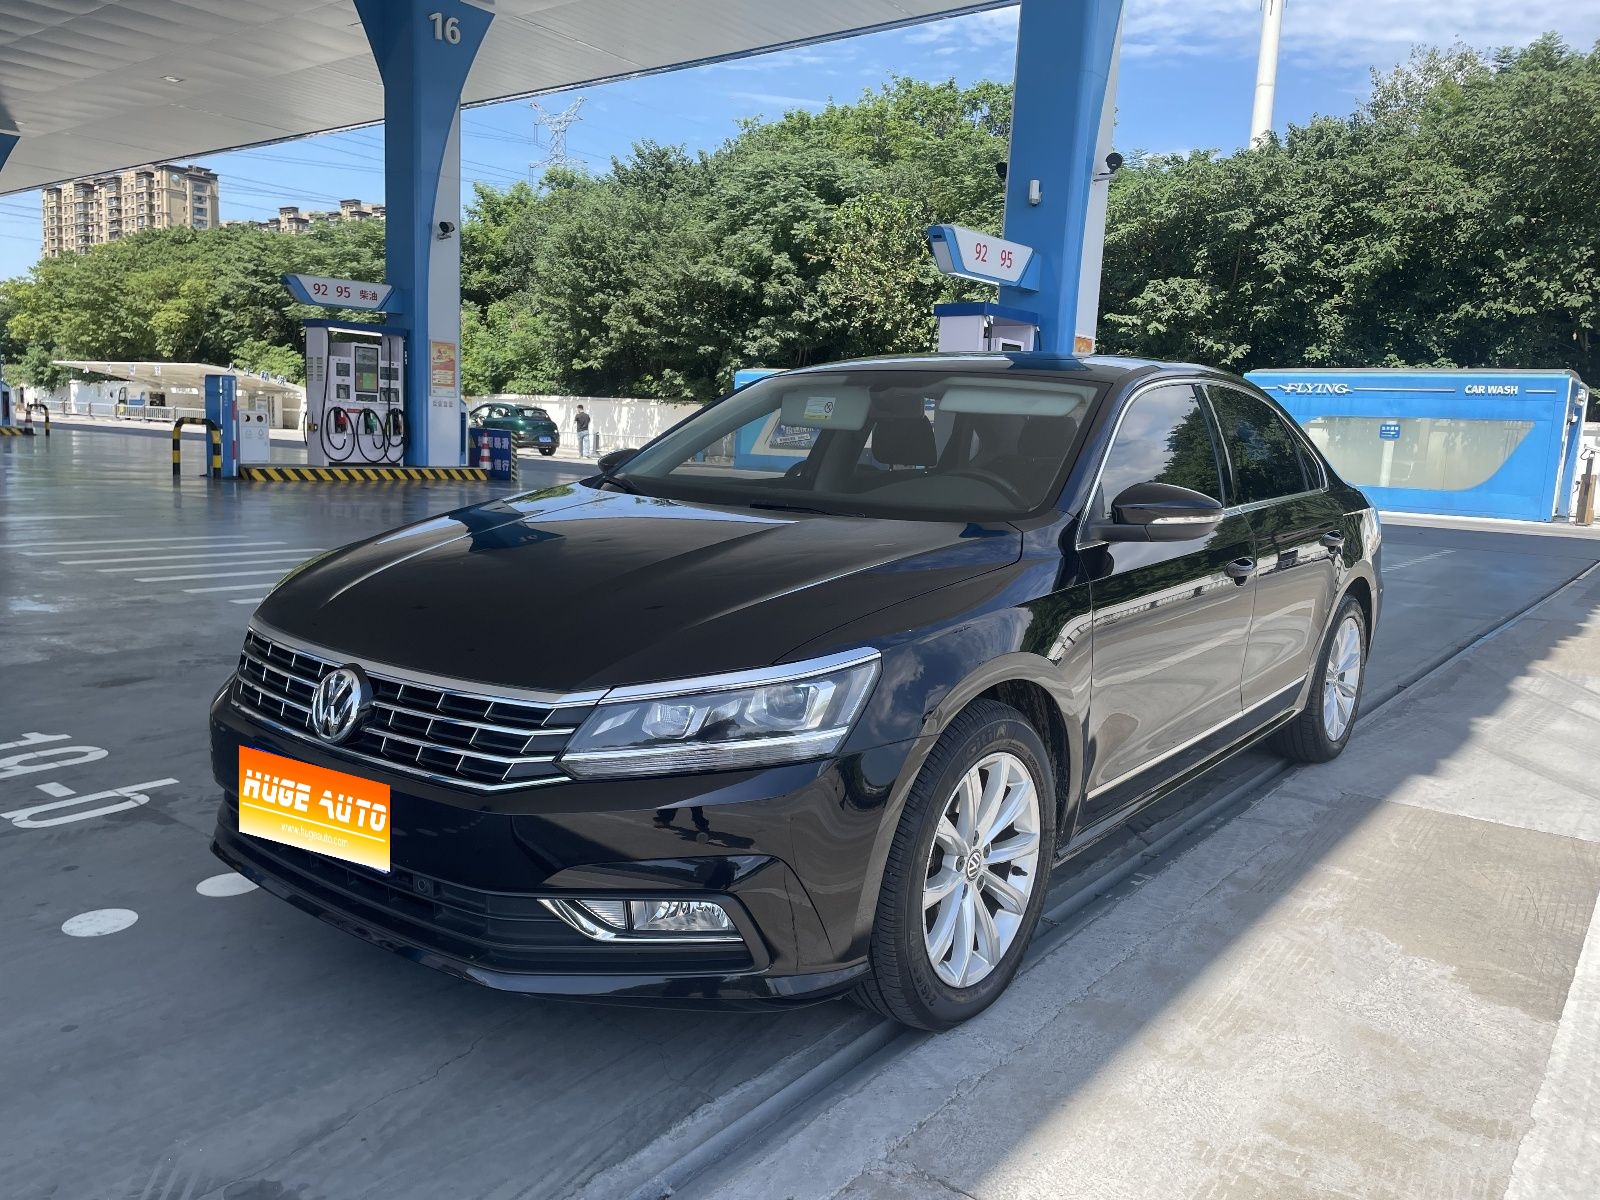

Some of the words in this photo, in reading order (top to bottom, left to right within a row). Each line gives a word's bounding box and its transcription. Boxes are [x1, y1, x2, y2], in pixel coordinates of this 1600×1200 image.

[428, 12, 461, 45] 16
[975, 243, 987, 262] 92
[1000, 250, 1012, 268] 95
[313, 282, 328, 296] 92
[336, 285, 351, 299] 95
[359, 289, 378, 301] 柴油
[1281, 383, 1350, 395] FLYING
[1465, 384, 1486, 396] CAR
[1487, 385, 1519, 396] WASH
